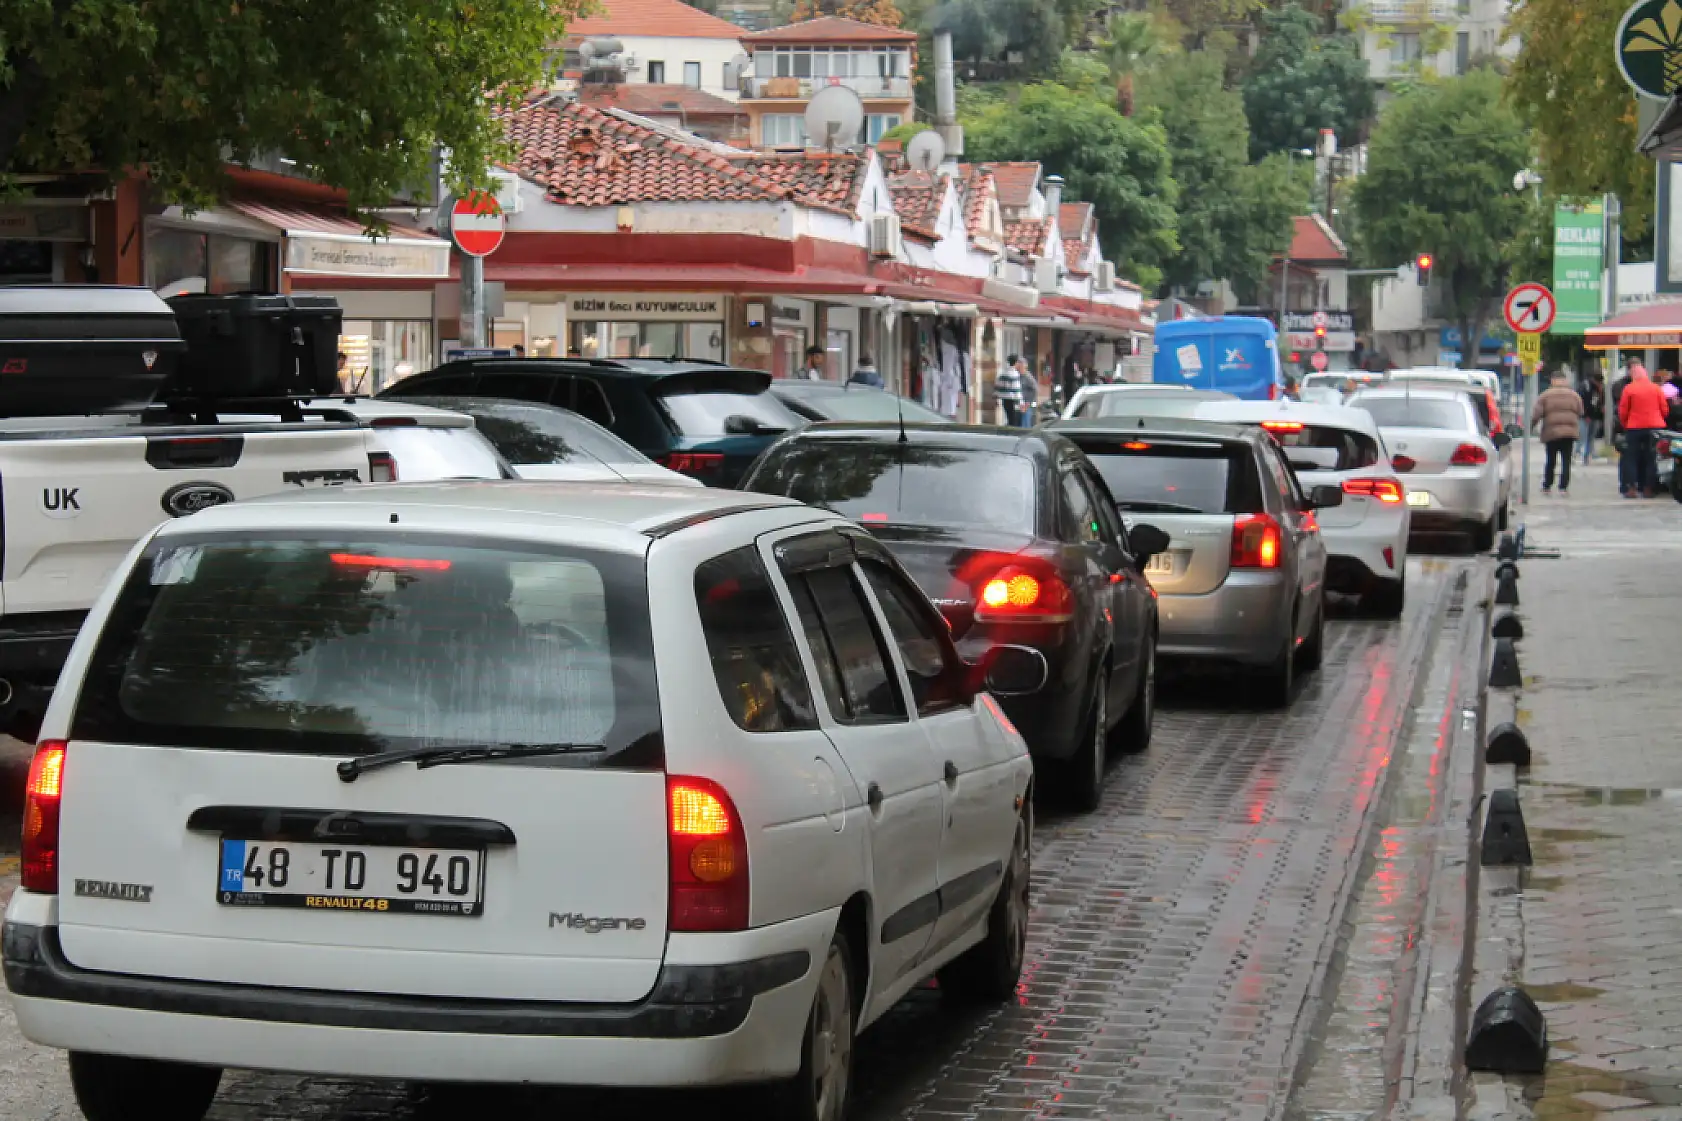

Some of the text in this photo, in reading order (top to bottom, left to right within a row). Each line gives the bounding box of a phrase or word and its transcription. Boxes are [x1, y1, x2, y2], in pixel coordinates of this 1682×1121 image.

[574, 298, 606, 312] BİZİM
[636, 301, 717, 313] KUYUMCULUK
[43, 488, 81, 511] UK
[226, 846, 470, 896] TR 48 TD 940
[74, 879, 153, 902] RENAULT
